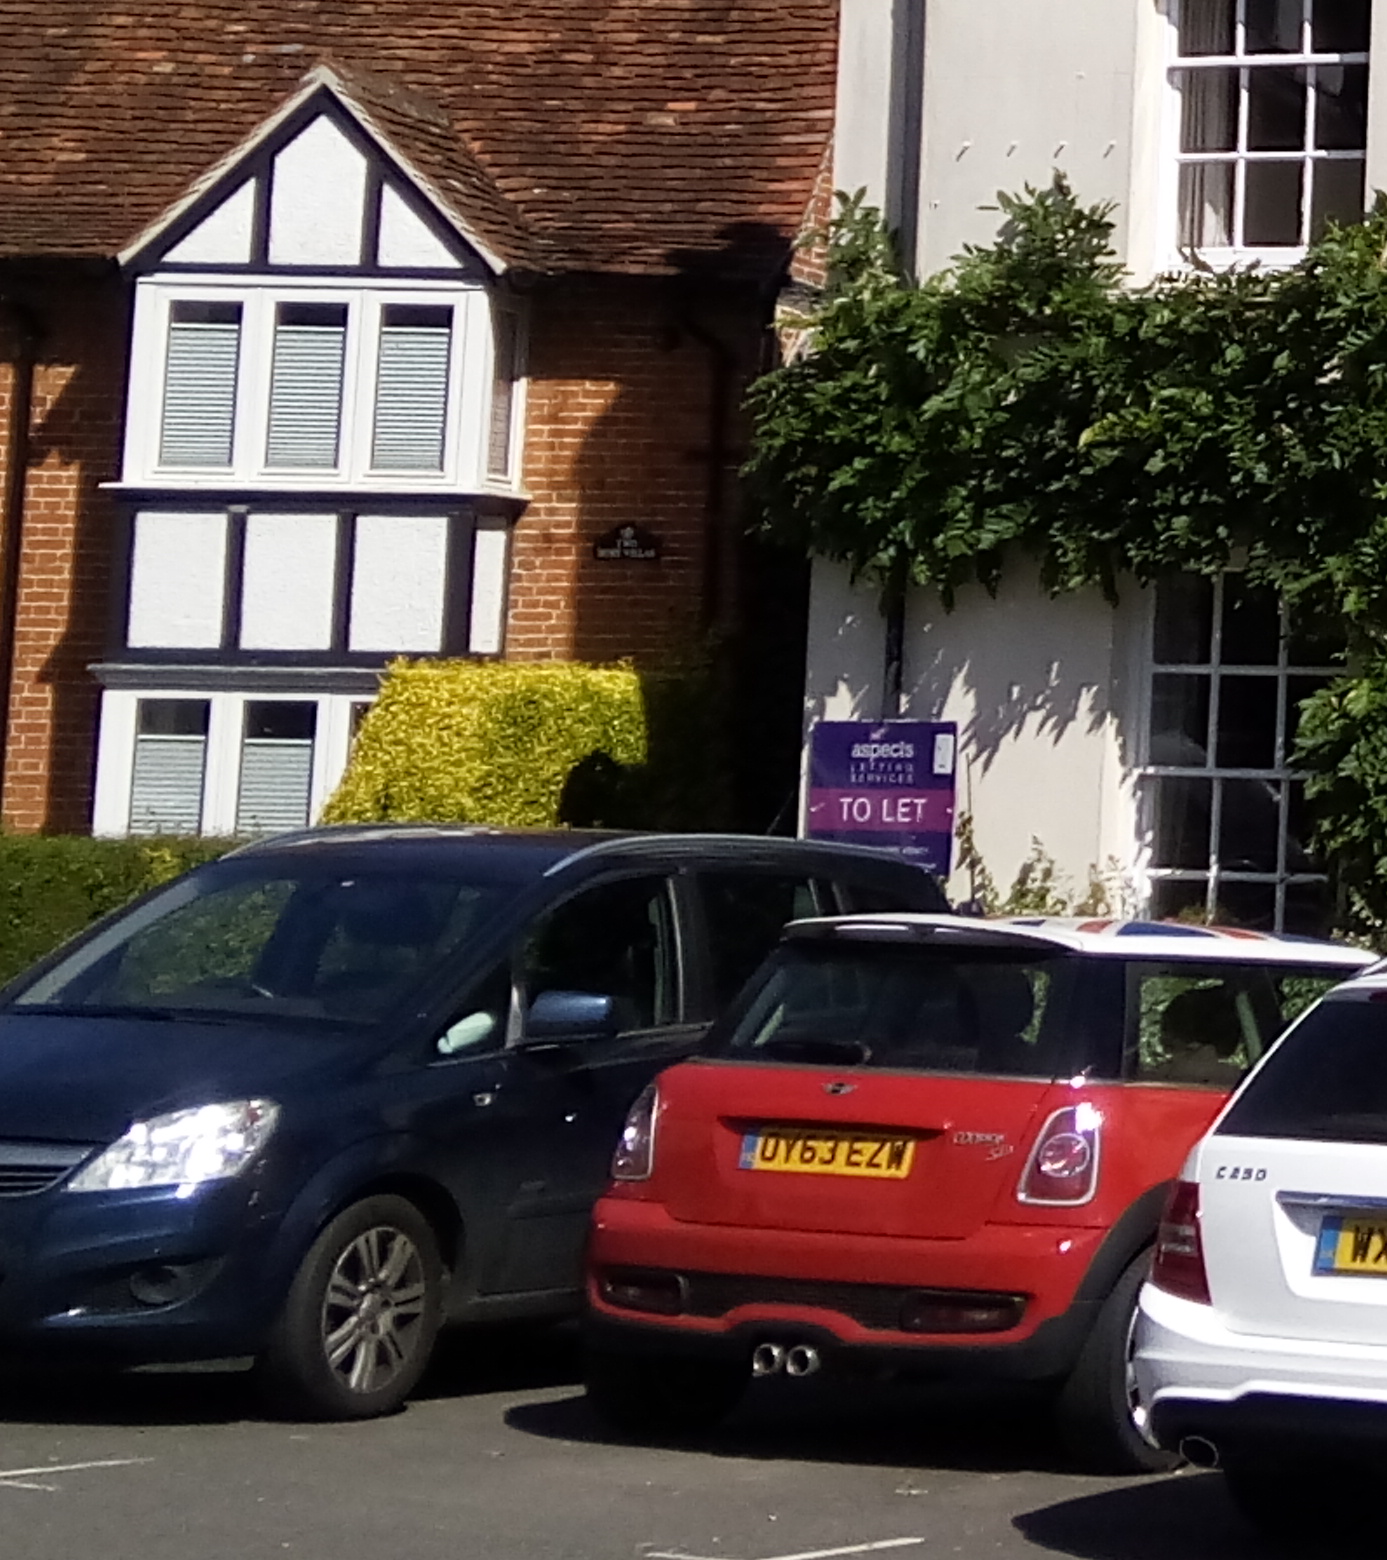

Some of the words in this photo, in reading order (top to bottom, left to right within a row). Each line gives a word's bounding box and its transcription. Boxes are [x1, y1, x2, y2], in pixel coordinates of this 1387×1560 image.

[851, 742, 914, 761] aspects
[839, 796, 871, 822] TO
[882, 797, 928, 823] LET
[760, 1132, 838, 1166] OY63
[1215, 1166, 1267, 1181] C250
